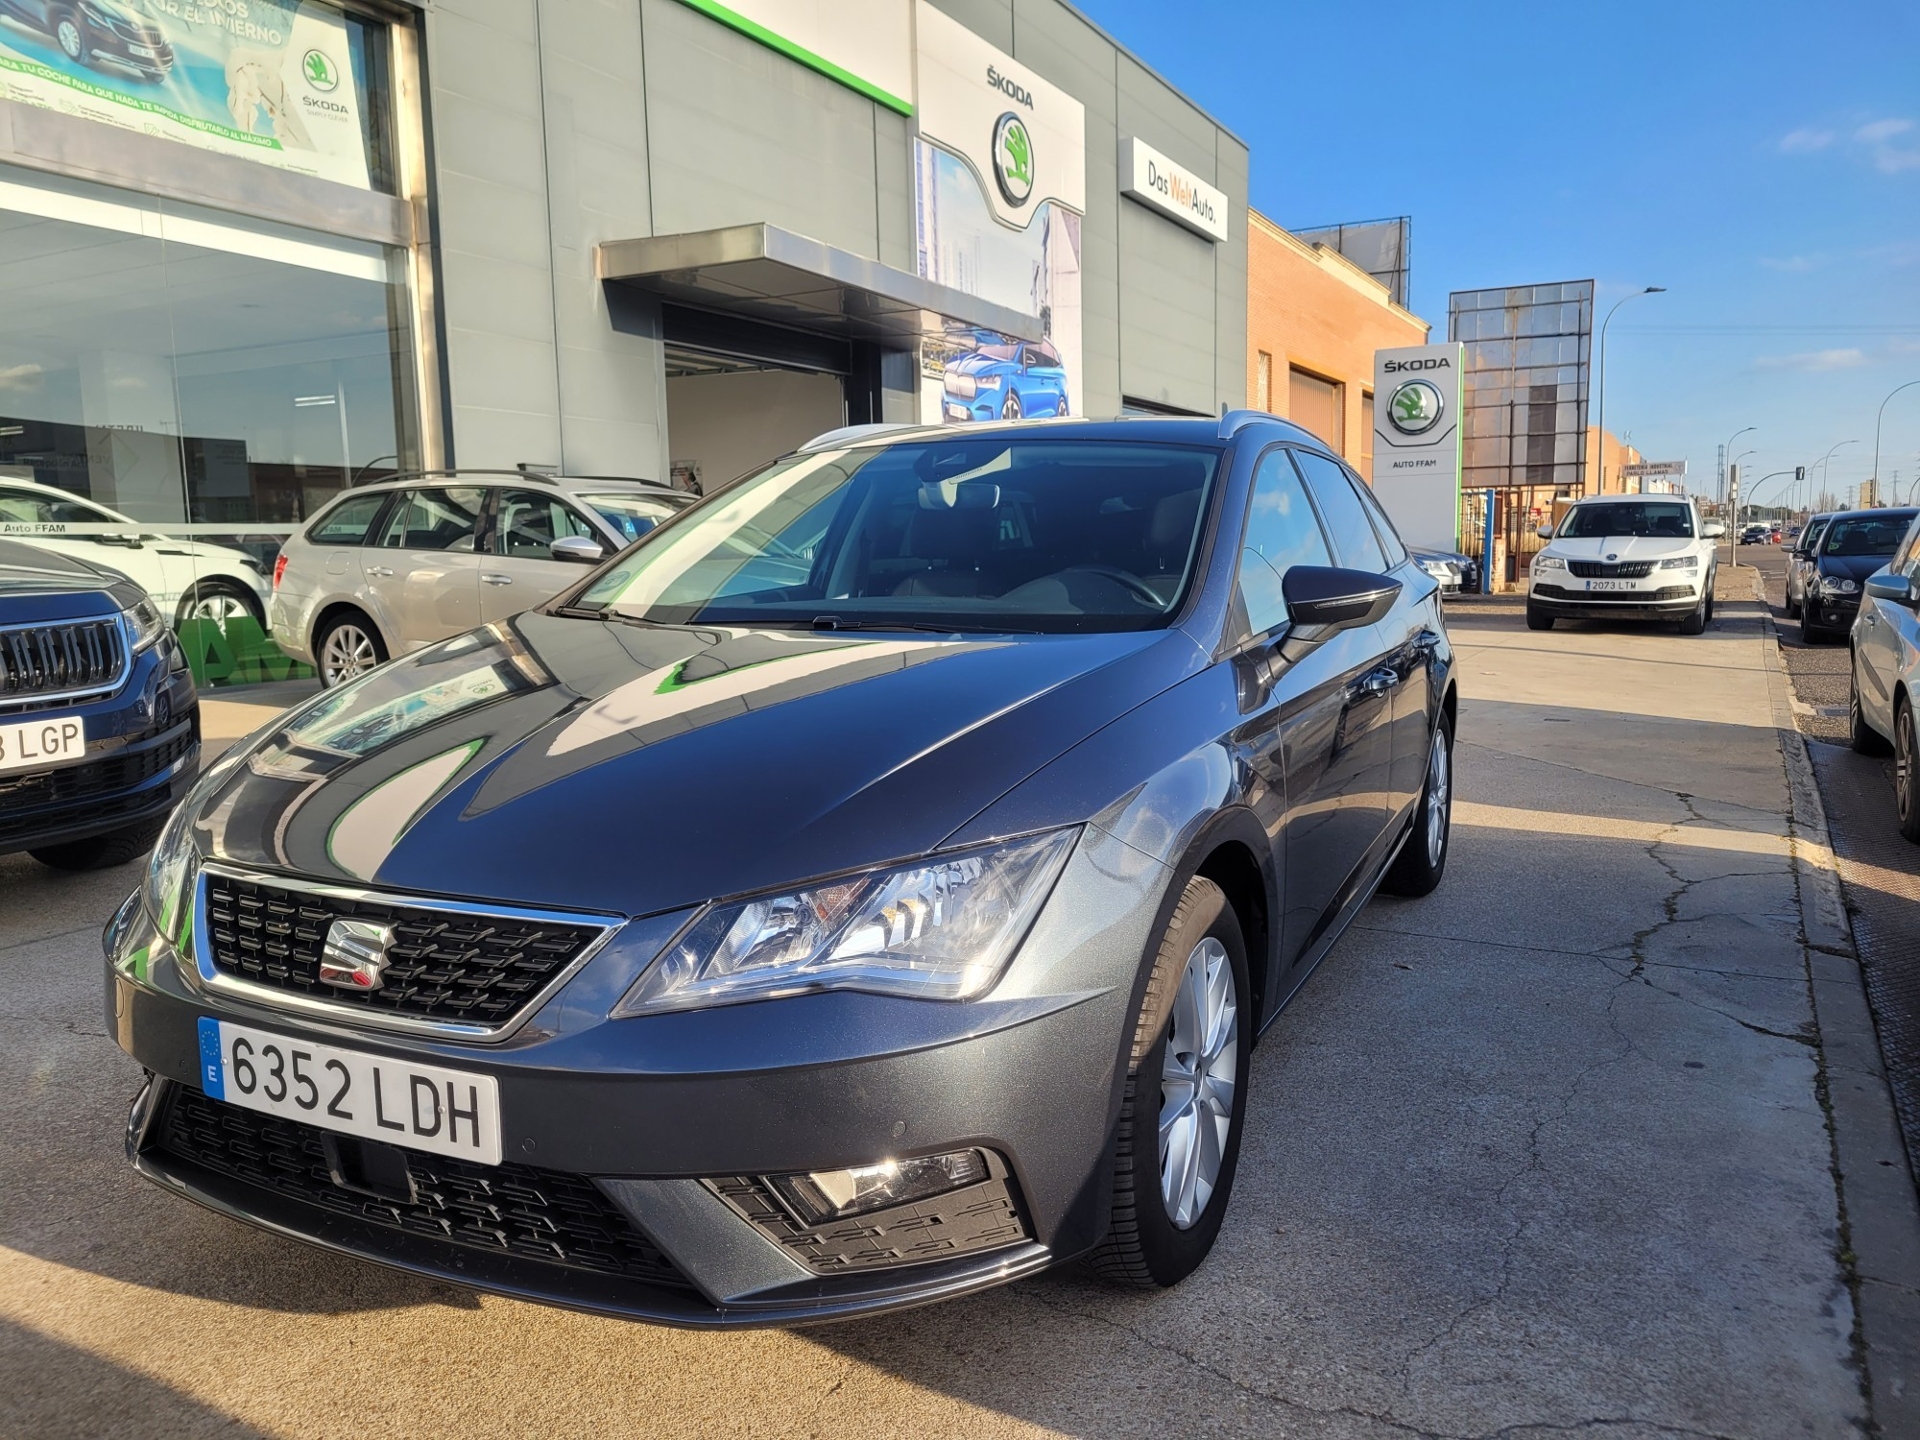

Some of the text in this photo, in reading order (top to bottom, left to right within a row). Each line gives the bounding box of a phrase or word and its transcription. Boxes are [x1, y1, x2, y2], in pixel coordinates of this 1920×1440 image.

[184, 6, 205, 23] EL
[987, 64, 1034, 110] ŠKODA
[21, 63, 34, 73] TU
[37, 67, 71, 84] COCHE
[73, 79, 94, 94] PARA
[96, 88, 114, 100] QUE
[116, 95, 139, 107] NADA
[141, 101, 153, 110] TE
[230, 131, 239, 140] AL
[303, 95, 349, 114] ŠKODA
[1149, 160, 1168, 195] Das
[1384, 358, 1451, 373] ŠKODA
[4, 524, 66, 533] Auto FFAM
[1592, 581, 1637, 590] 2073 LTM
[18, 723, 78, 759] LGP
[207, 1064, 218, 1083] E
[232, 1037, 480, 1148] 6352 LDH
